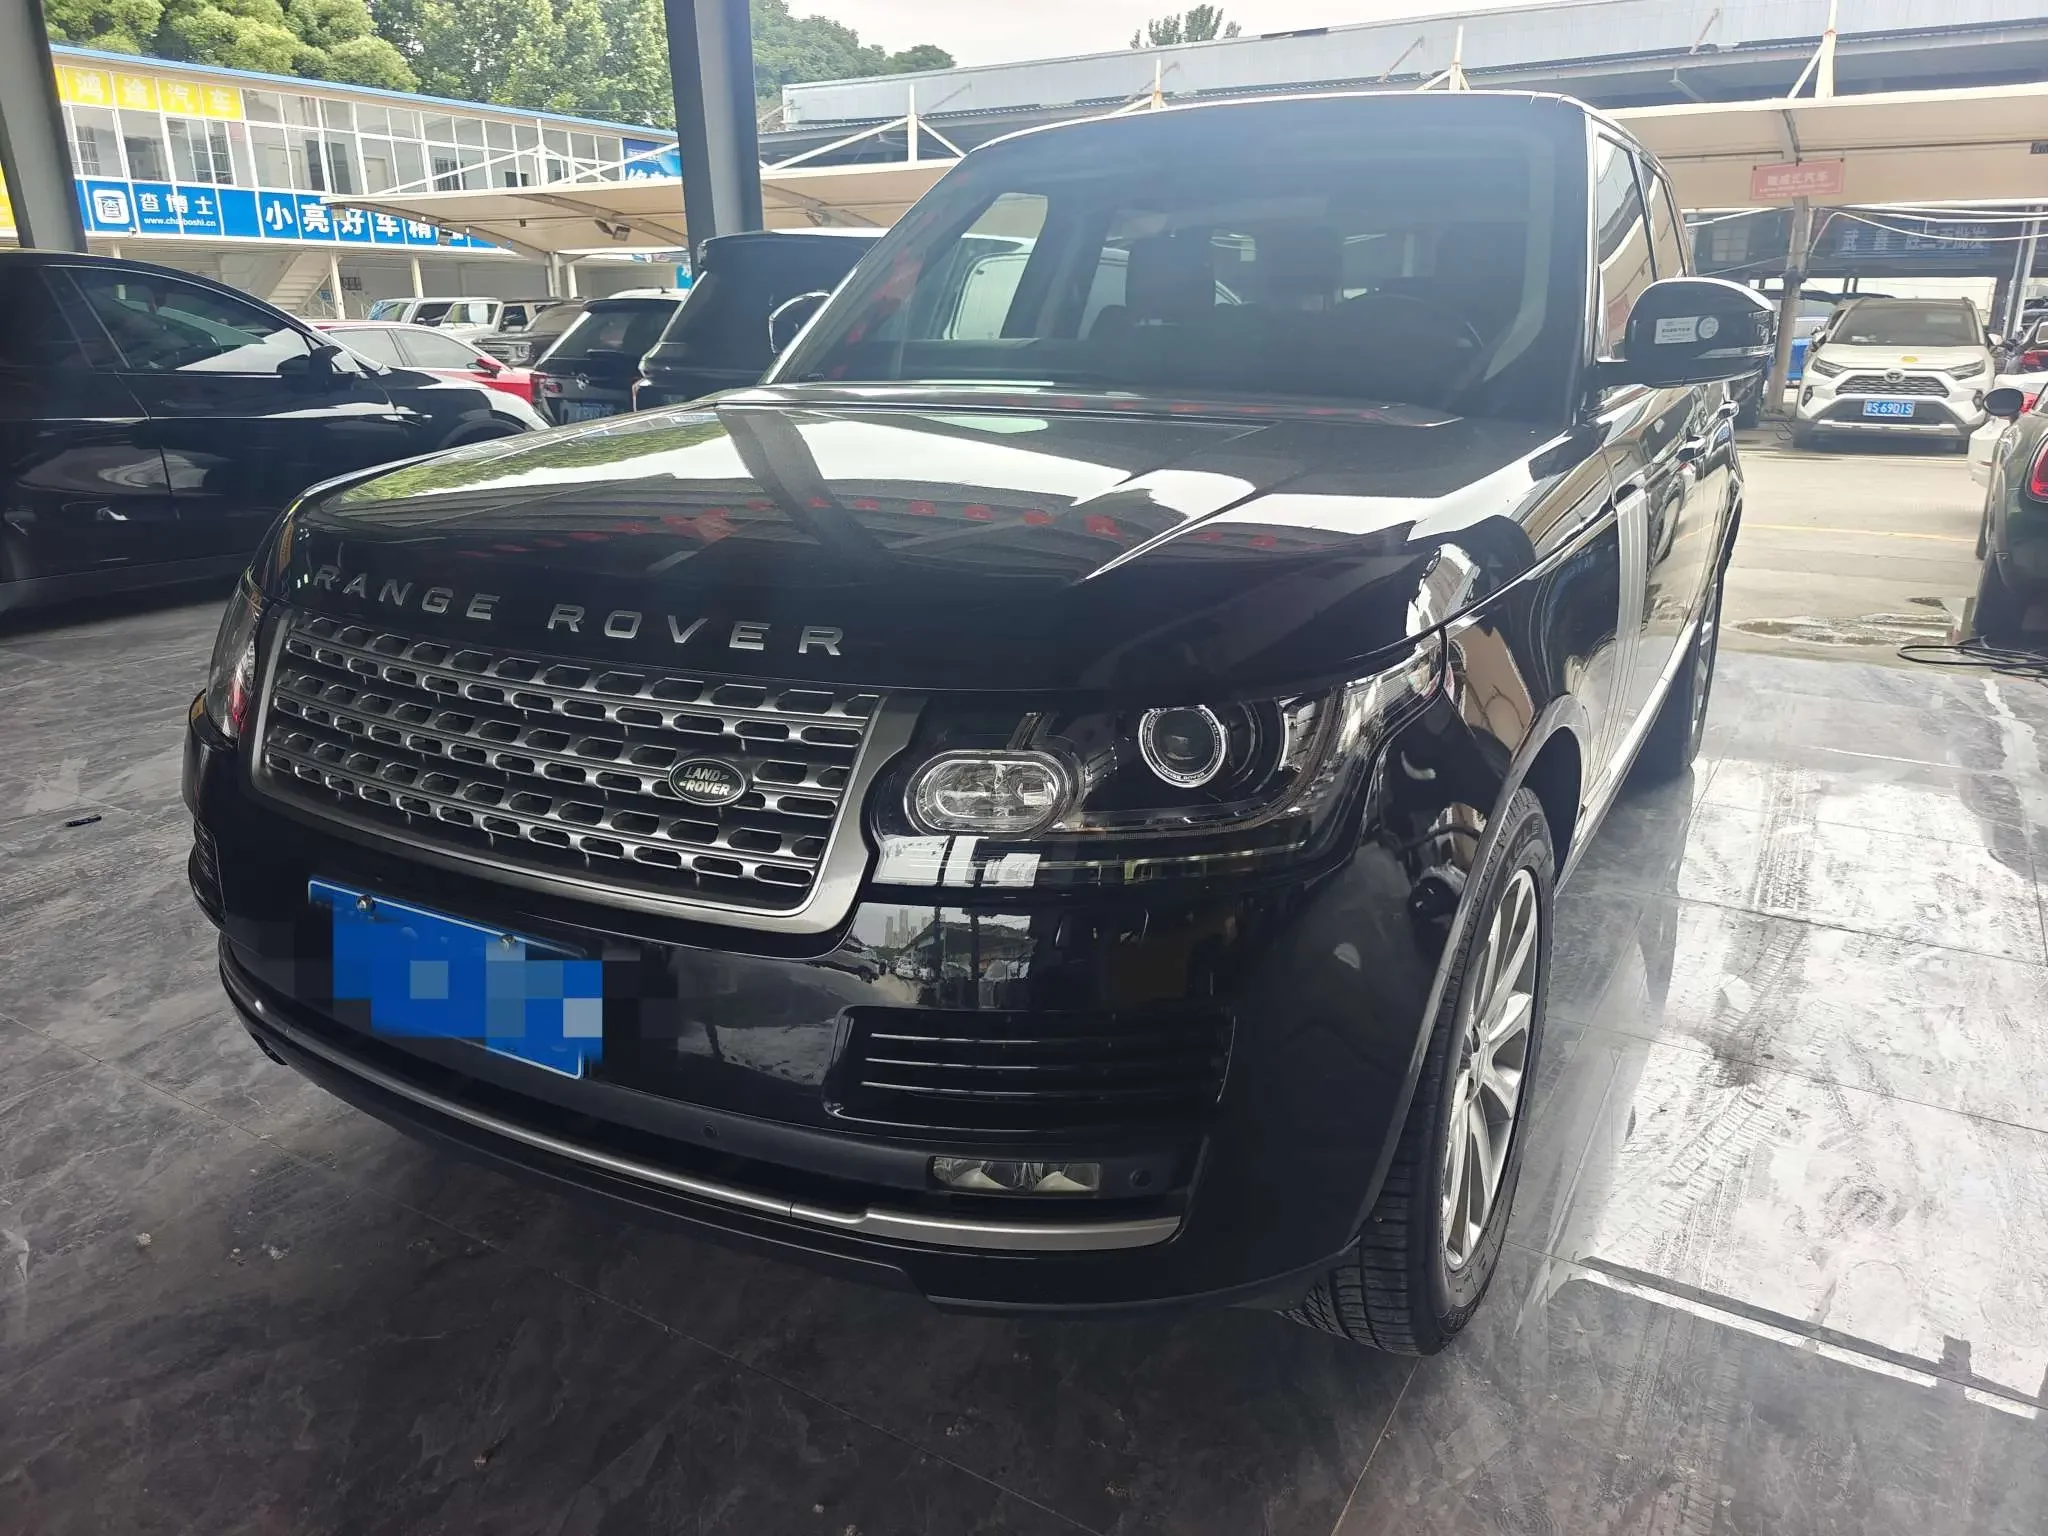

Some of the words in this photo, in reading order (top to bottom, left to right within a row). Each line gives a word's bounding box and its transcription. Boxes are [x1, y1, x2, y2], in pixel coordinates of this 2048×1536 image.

[139, 192, 214, 215] 查博士
[265, 200, 464, 240] 小亮好车精
[313, 564, 500, 621] RANGE
[547, 603, 844, 656] ROVER
[684, 767, 721, 781] LAND
[685, 780, 731, 796] ROVER
